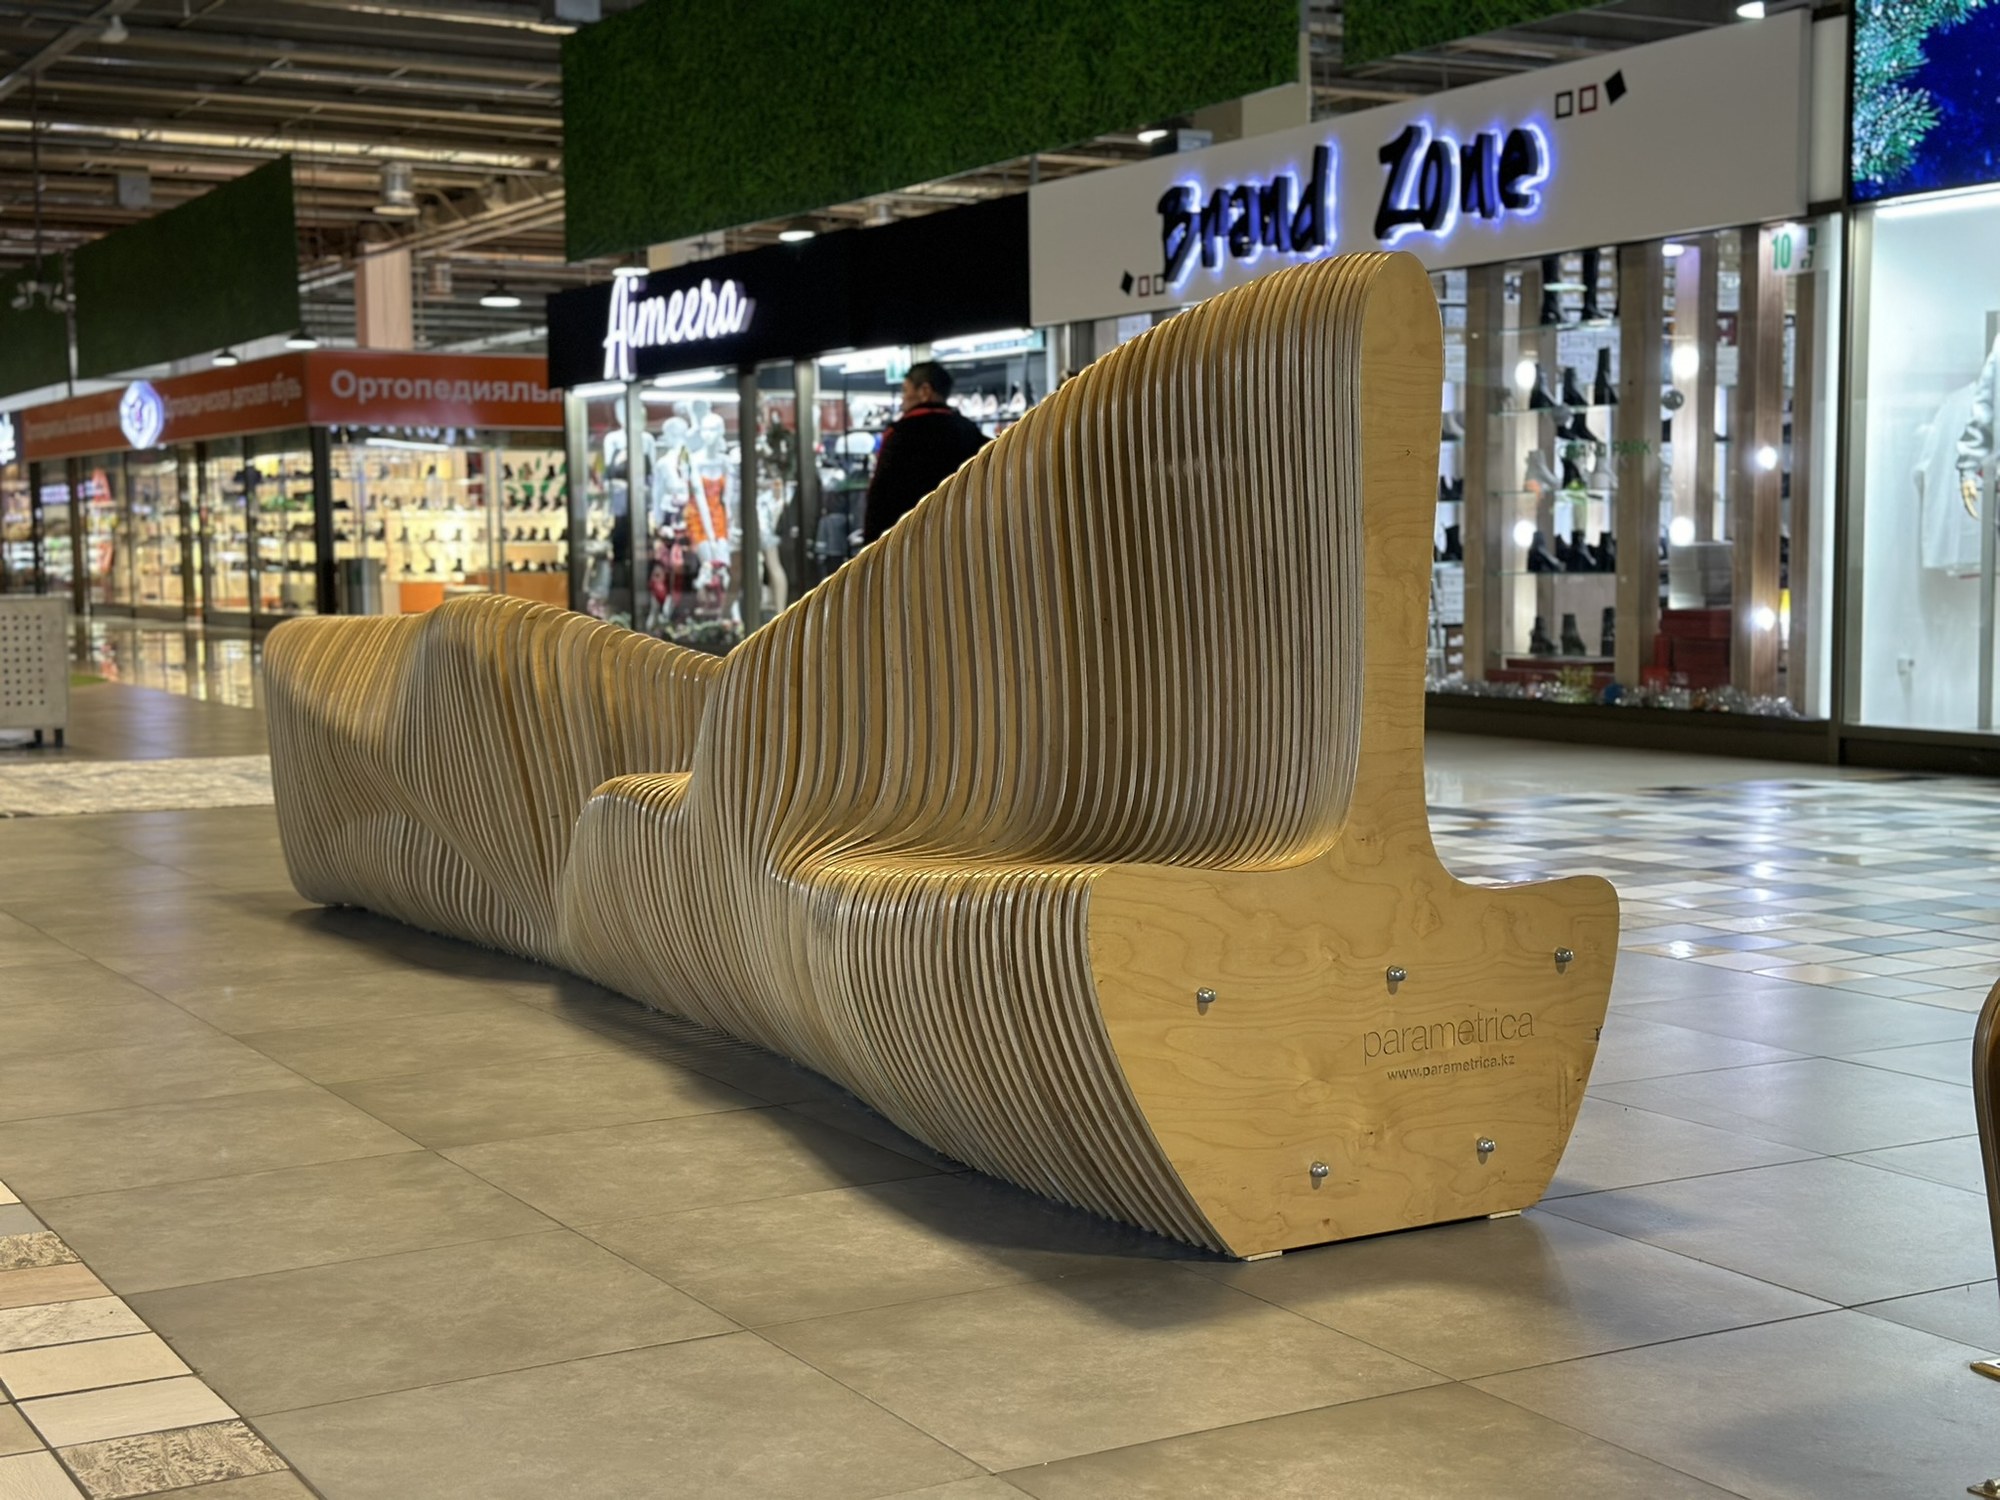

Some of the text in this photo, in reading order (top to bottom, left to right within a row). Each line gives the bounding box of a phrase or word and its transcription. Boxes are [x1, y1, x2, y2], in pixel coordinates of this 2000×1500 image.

[1157, 122, 1549, 287] Brand Zone
[603, 274, 754, 380] Aimeera
[1363, 1007, 1535, 1066] parametrica
[1387, 1053, 1515, 1081] www.parametrica.kz
